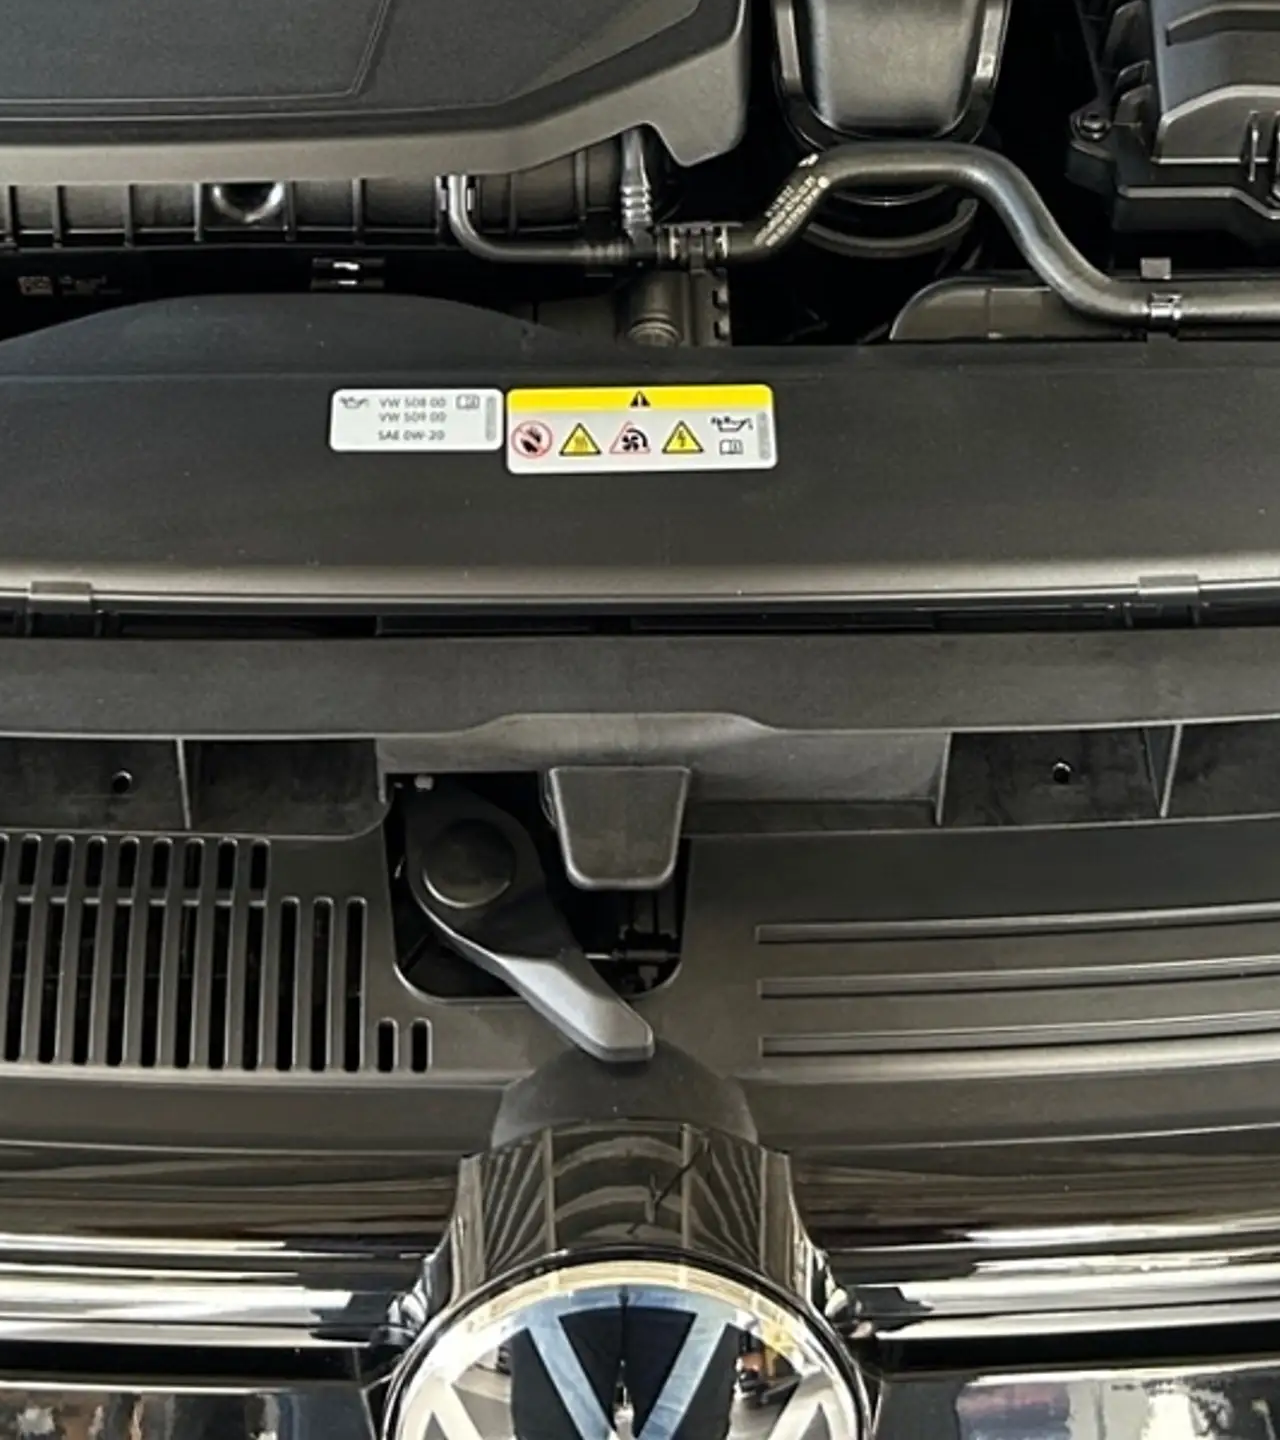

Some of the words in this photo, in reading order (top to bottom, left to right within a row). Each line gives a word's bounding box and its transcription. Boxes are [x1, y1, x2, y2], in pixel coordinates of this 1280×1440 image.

[379, 397, 400, 408] VW
[404, 397, 426, 408] 508
[429, 397, 447, 408] 00
[379, 412, 400, 423] VW
[429, 412, 447, 423] 00
[378, 430, 400, 441] SAE
